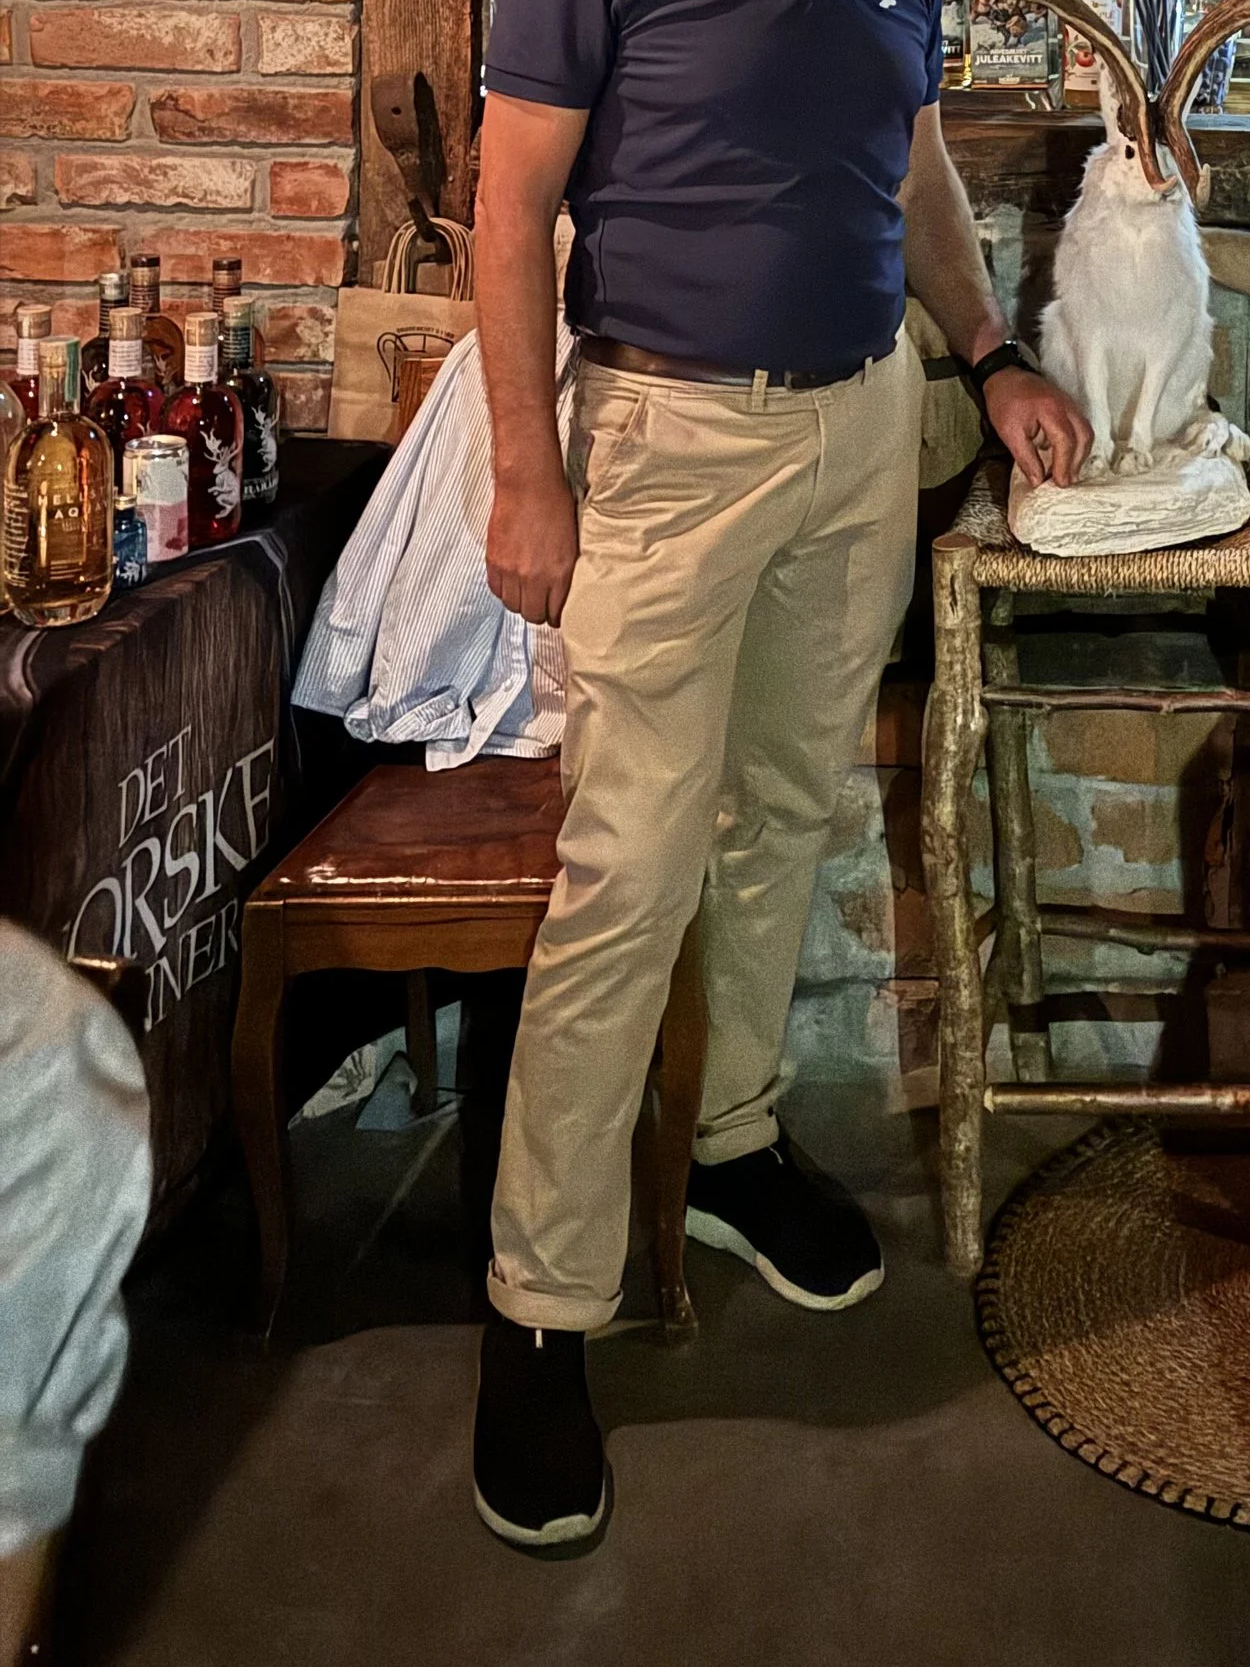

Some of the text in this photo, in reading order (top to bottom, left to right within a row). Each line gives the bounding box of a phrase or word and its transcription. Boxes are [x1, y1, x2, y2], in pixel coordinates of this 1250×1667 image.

[975, 54, 1043, 66] JULEAKEVITT
[117, 723, 192, 849] DET
[62, 736, 276, 963] ORSKE
